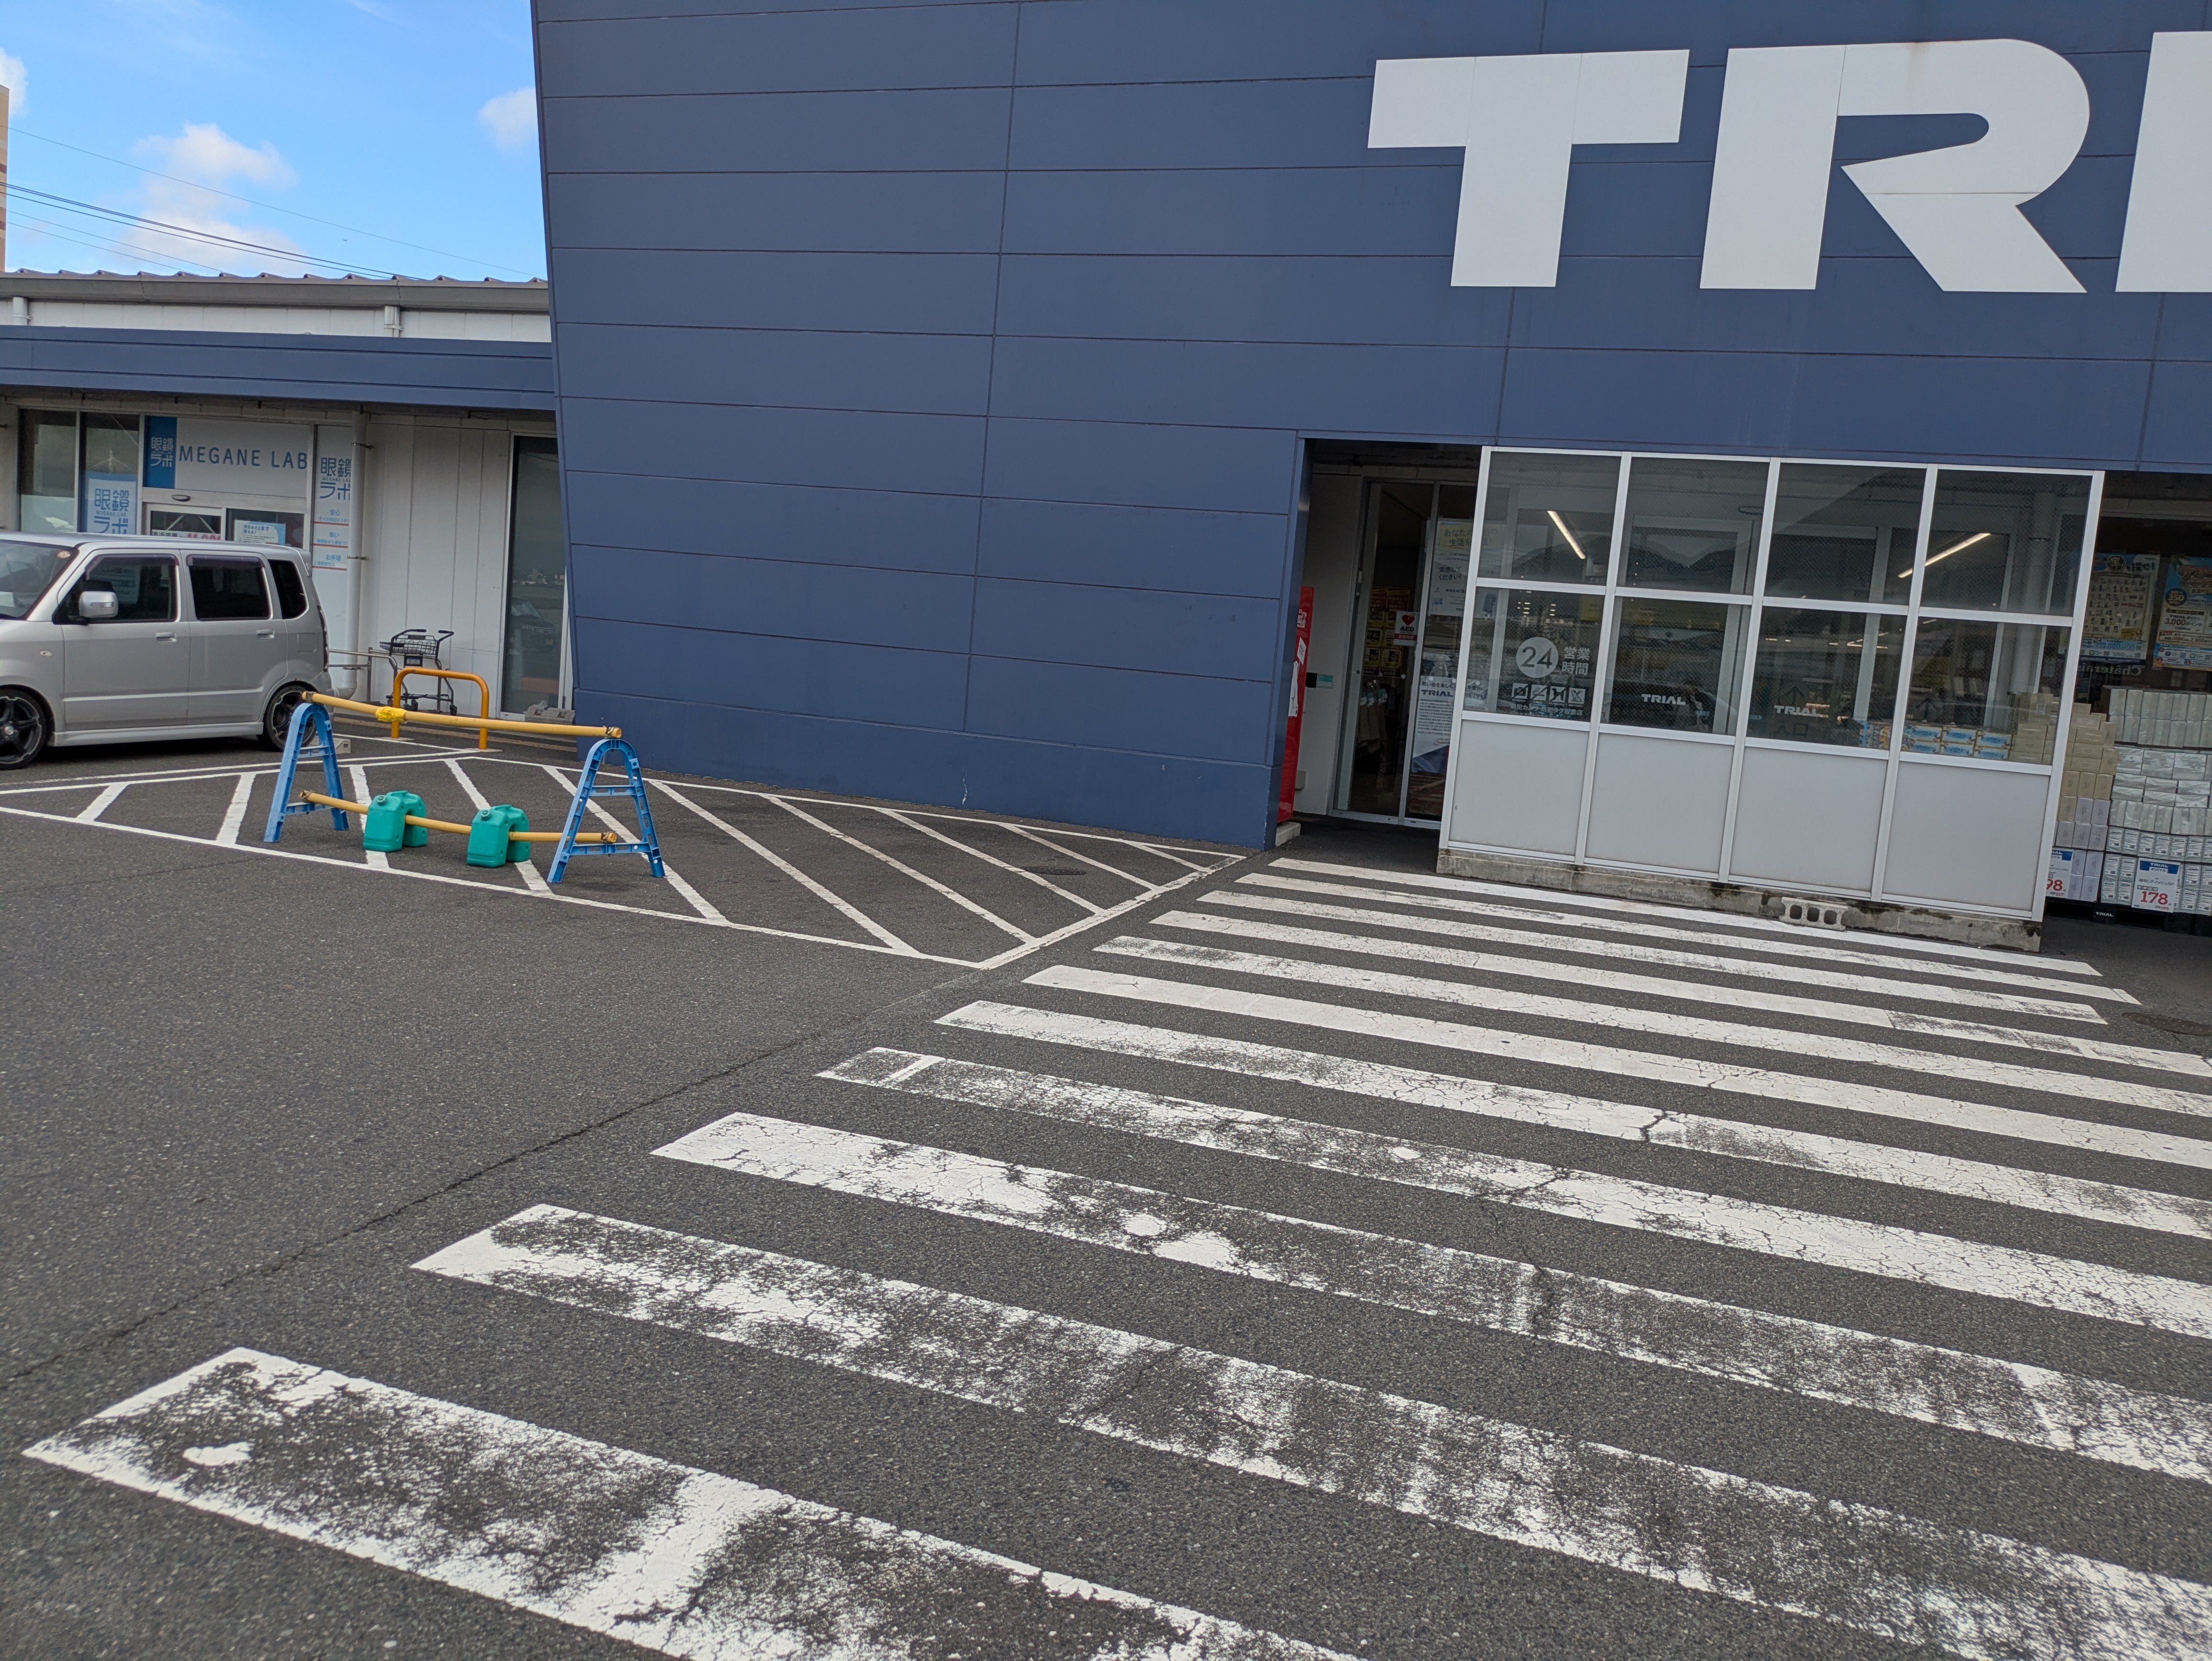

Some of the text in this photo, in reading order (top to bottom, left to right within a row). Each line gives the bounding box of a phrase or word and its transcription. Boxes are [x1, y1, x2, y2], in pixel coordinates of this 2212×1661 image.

[151, 437, 173, 451] 眼鏡
[151, 454, 173, 467] ラボ
[179, 445, 308, 469] MEGANE LAB
[320, 482, 351, 500] ラボ
[95, 488, 129, 511] 眼鏡
[1520, 646, 1552, 669] 24
[1564, 646, 1590, 660] 営業
[1561, 661, 1589, 676] 時間
[1421, 689, 1453, 697] TRIAL
[1641, 694, 1686, 705] TRIAL
[1774, 705, 1821, 717] TRIAL
[2141, 891, 2168, 905] 178
